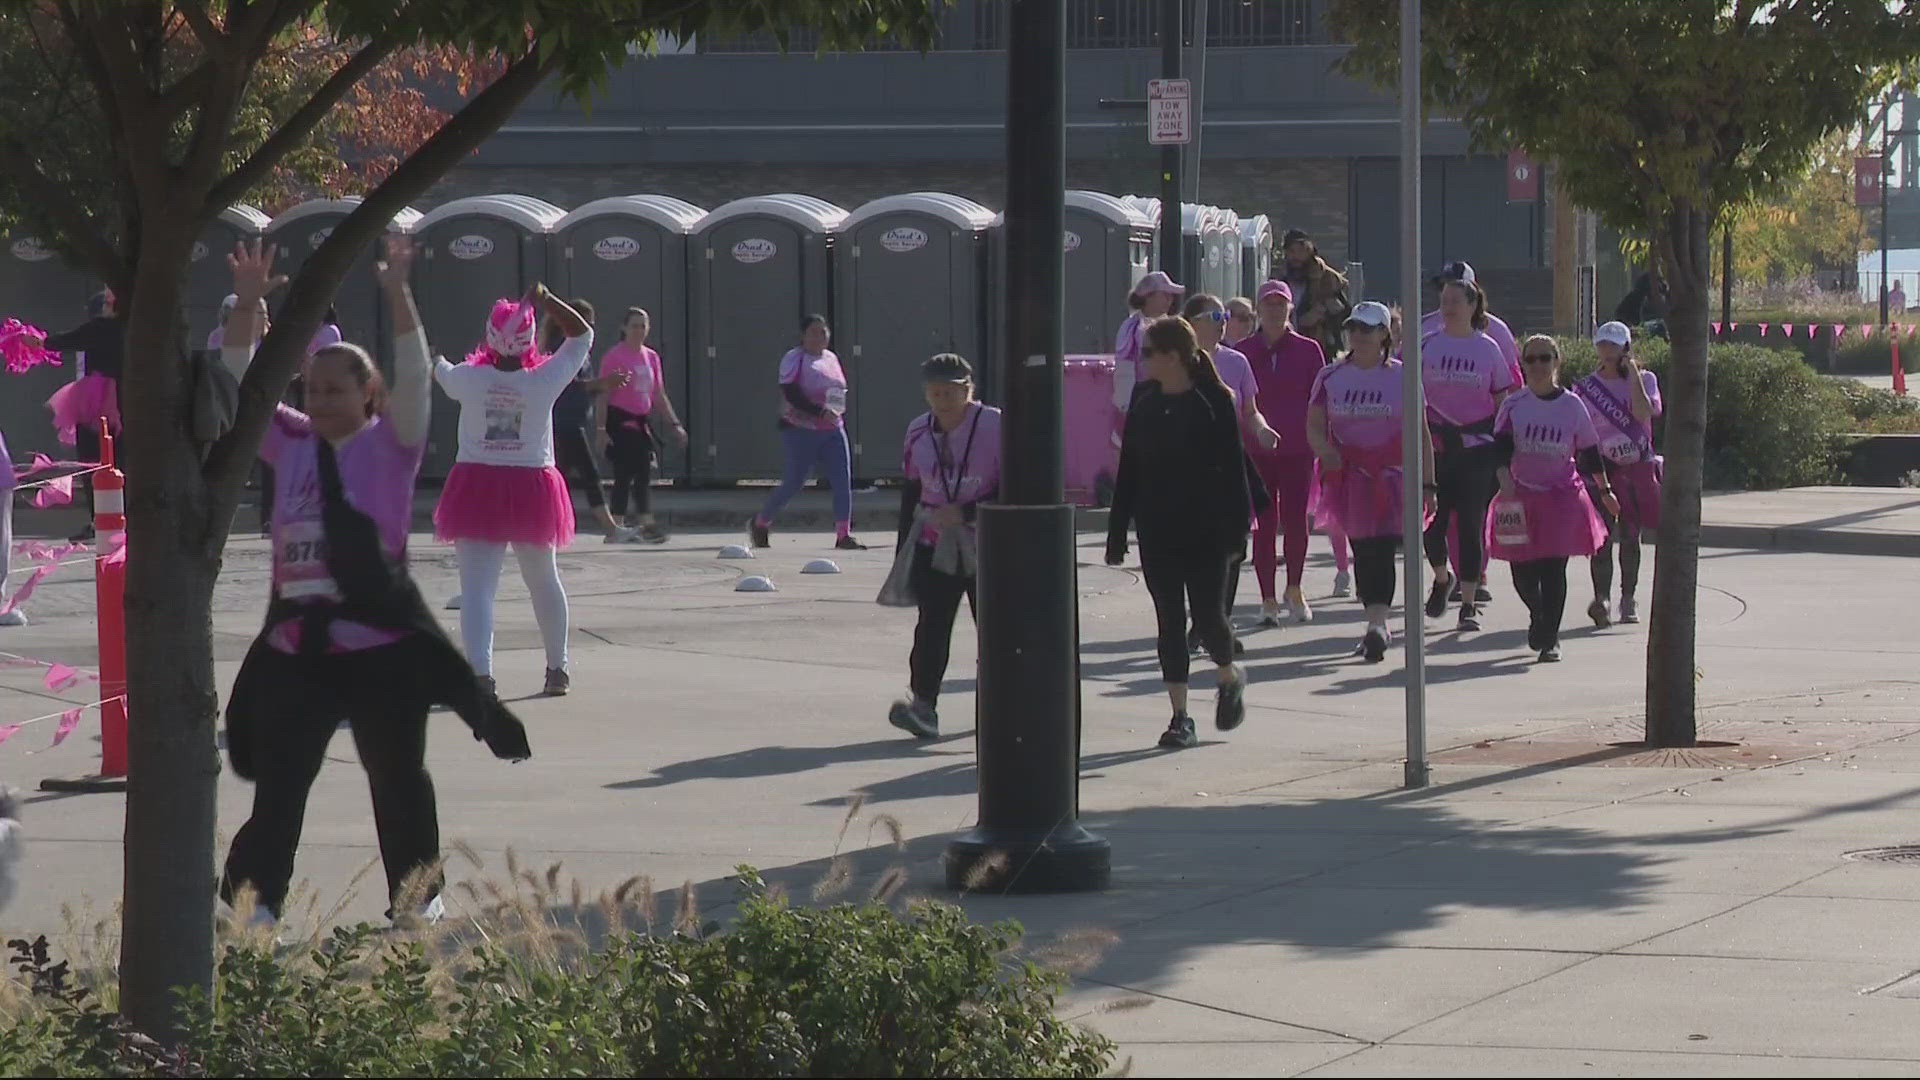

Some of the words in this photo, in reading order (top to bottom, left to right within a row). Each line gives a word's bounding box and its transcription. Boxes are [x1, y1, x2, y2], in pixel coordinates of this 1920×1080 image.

[1160, 101, 1180, 110] TOW
[1157, 112, 1182, 120] AWAY
[1157, 121, 1183, 130] ZONE
[1580, 376, 1631, 428] SURVIVOR
